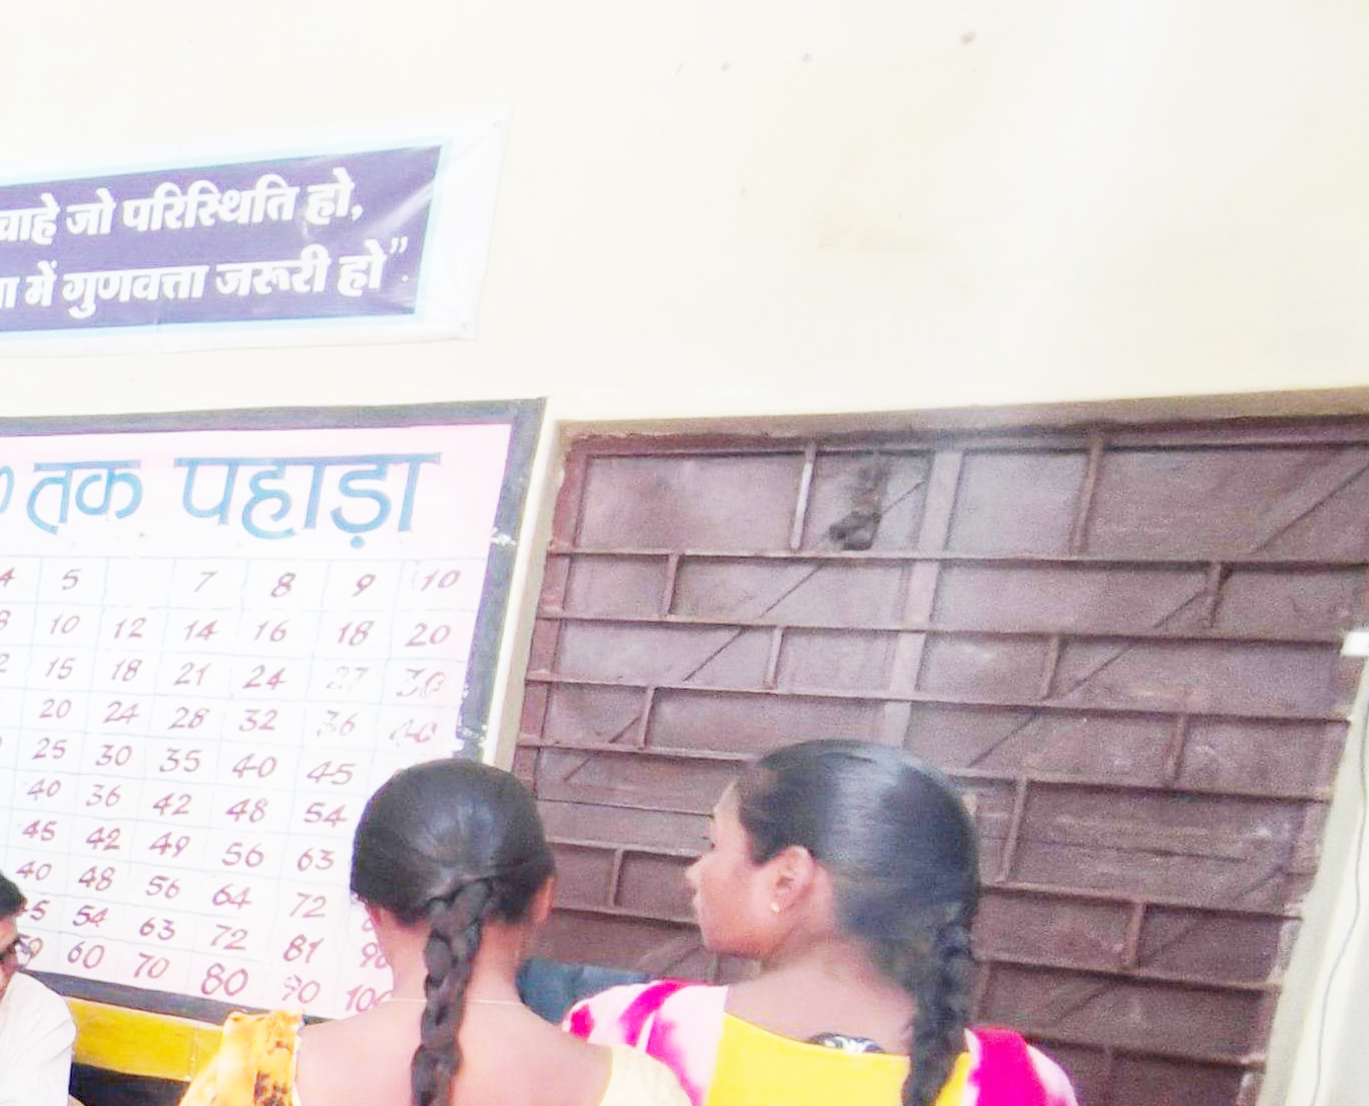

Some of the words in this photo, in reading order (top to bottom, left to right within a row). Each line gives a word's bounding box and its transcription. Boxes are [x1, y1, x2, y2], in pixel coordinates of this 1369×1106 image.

[66, 187, 116, 238] जो
[122, 173, 300, 232] परिस्थिति
[305, 166, 364, 226] हो,
[24, 260, 58, 308] में
[62, 263, 209, 320] गुणवत्ता
[215, 243, 330, 297] जरूरी
[26, 459, 143, 535] तक
[174, 452, 442, 549] पहाड़ा
[62, 568, 83, 591] 5
[194, 571, 219, 593] 7
[270, 572, 296, 598] 8
[352, 574, 376, 597] 9
[420, 569, 461, 592] 10
[49, 613, 80, 635] 10
[113, 616, 147, 639] 12
[183, 619, 219, 641] 14
[253, 619, 289, 643] 16
[336, 619, 374, 647] 18
[404, 621, 452, 648] 20
[44, 656, 76, 680] 15
[110, 659, 143, 682] 18
[173, 662, 212, 686] 21
[242, 664, 287, 690] 24
[39, 699, 72, 719] 20
[103, 700, 140, 724] 24
[167, 706, 211, 730] 28
[239, 708, 279, 732] 32
[32, 737, 68, 760] 25
[95, 744, 132, 767] 30
[158, 748, 204, 773] 35
[232, 752, 278, 780] 40
[306, 761, 357, 786] 45
[27, 778, 62, 801] 40
[85, 784, 122, 808] 36
[152, 793, 193, 817] 42
[224, 797, 269, 824] 48
[303, 802, 348, 828] 54
[22, 820, 58, 842] 45
[85, 827, 121, 852] 42
[148, 831, 191, 858] 49
[221, 842, 264, 868] 56
[297, 848, 334, 872] 63
[16, 860, 52, 881] 40
[78, 866, 116, 892] 48
[145, 875, 180, 900] 56
[211, 882, 253, 909] 64
[288, 892, 327, 918] 72
[71, 904, 110, 928] 54
[138, 916, 176, 941] 63
[209, 924, 248, 951] 72
[282, 934, 325, 964] 81
[66, 940, 105, 970] 60
[133, 952, 170, 979] 70
[201, 963, 249, 997] 80
